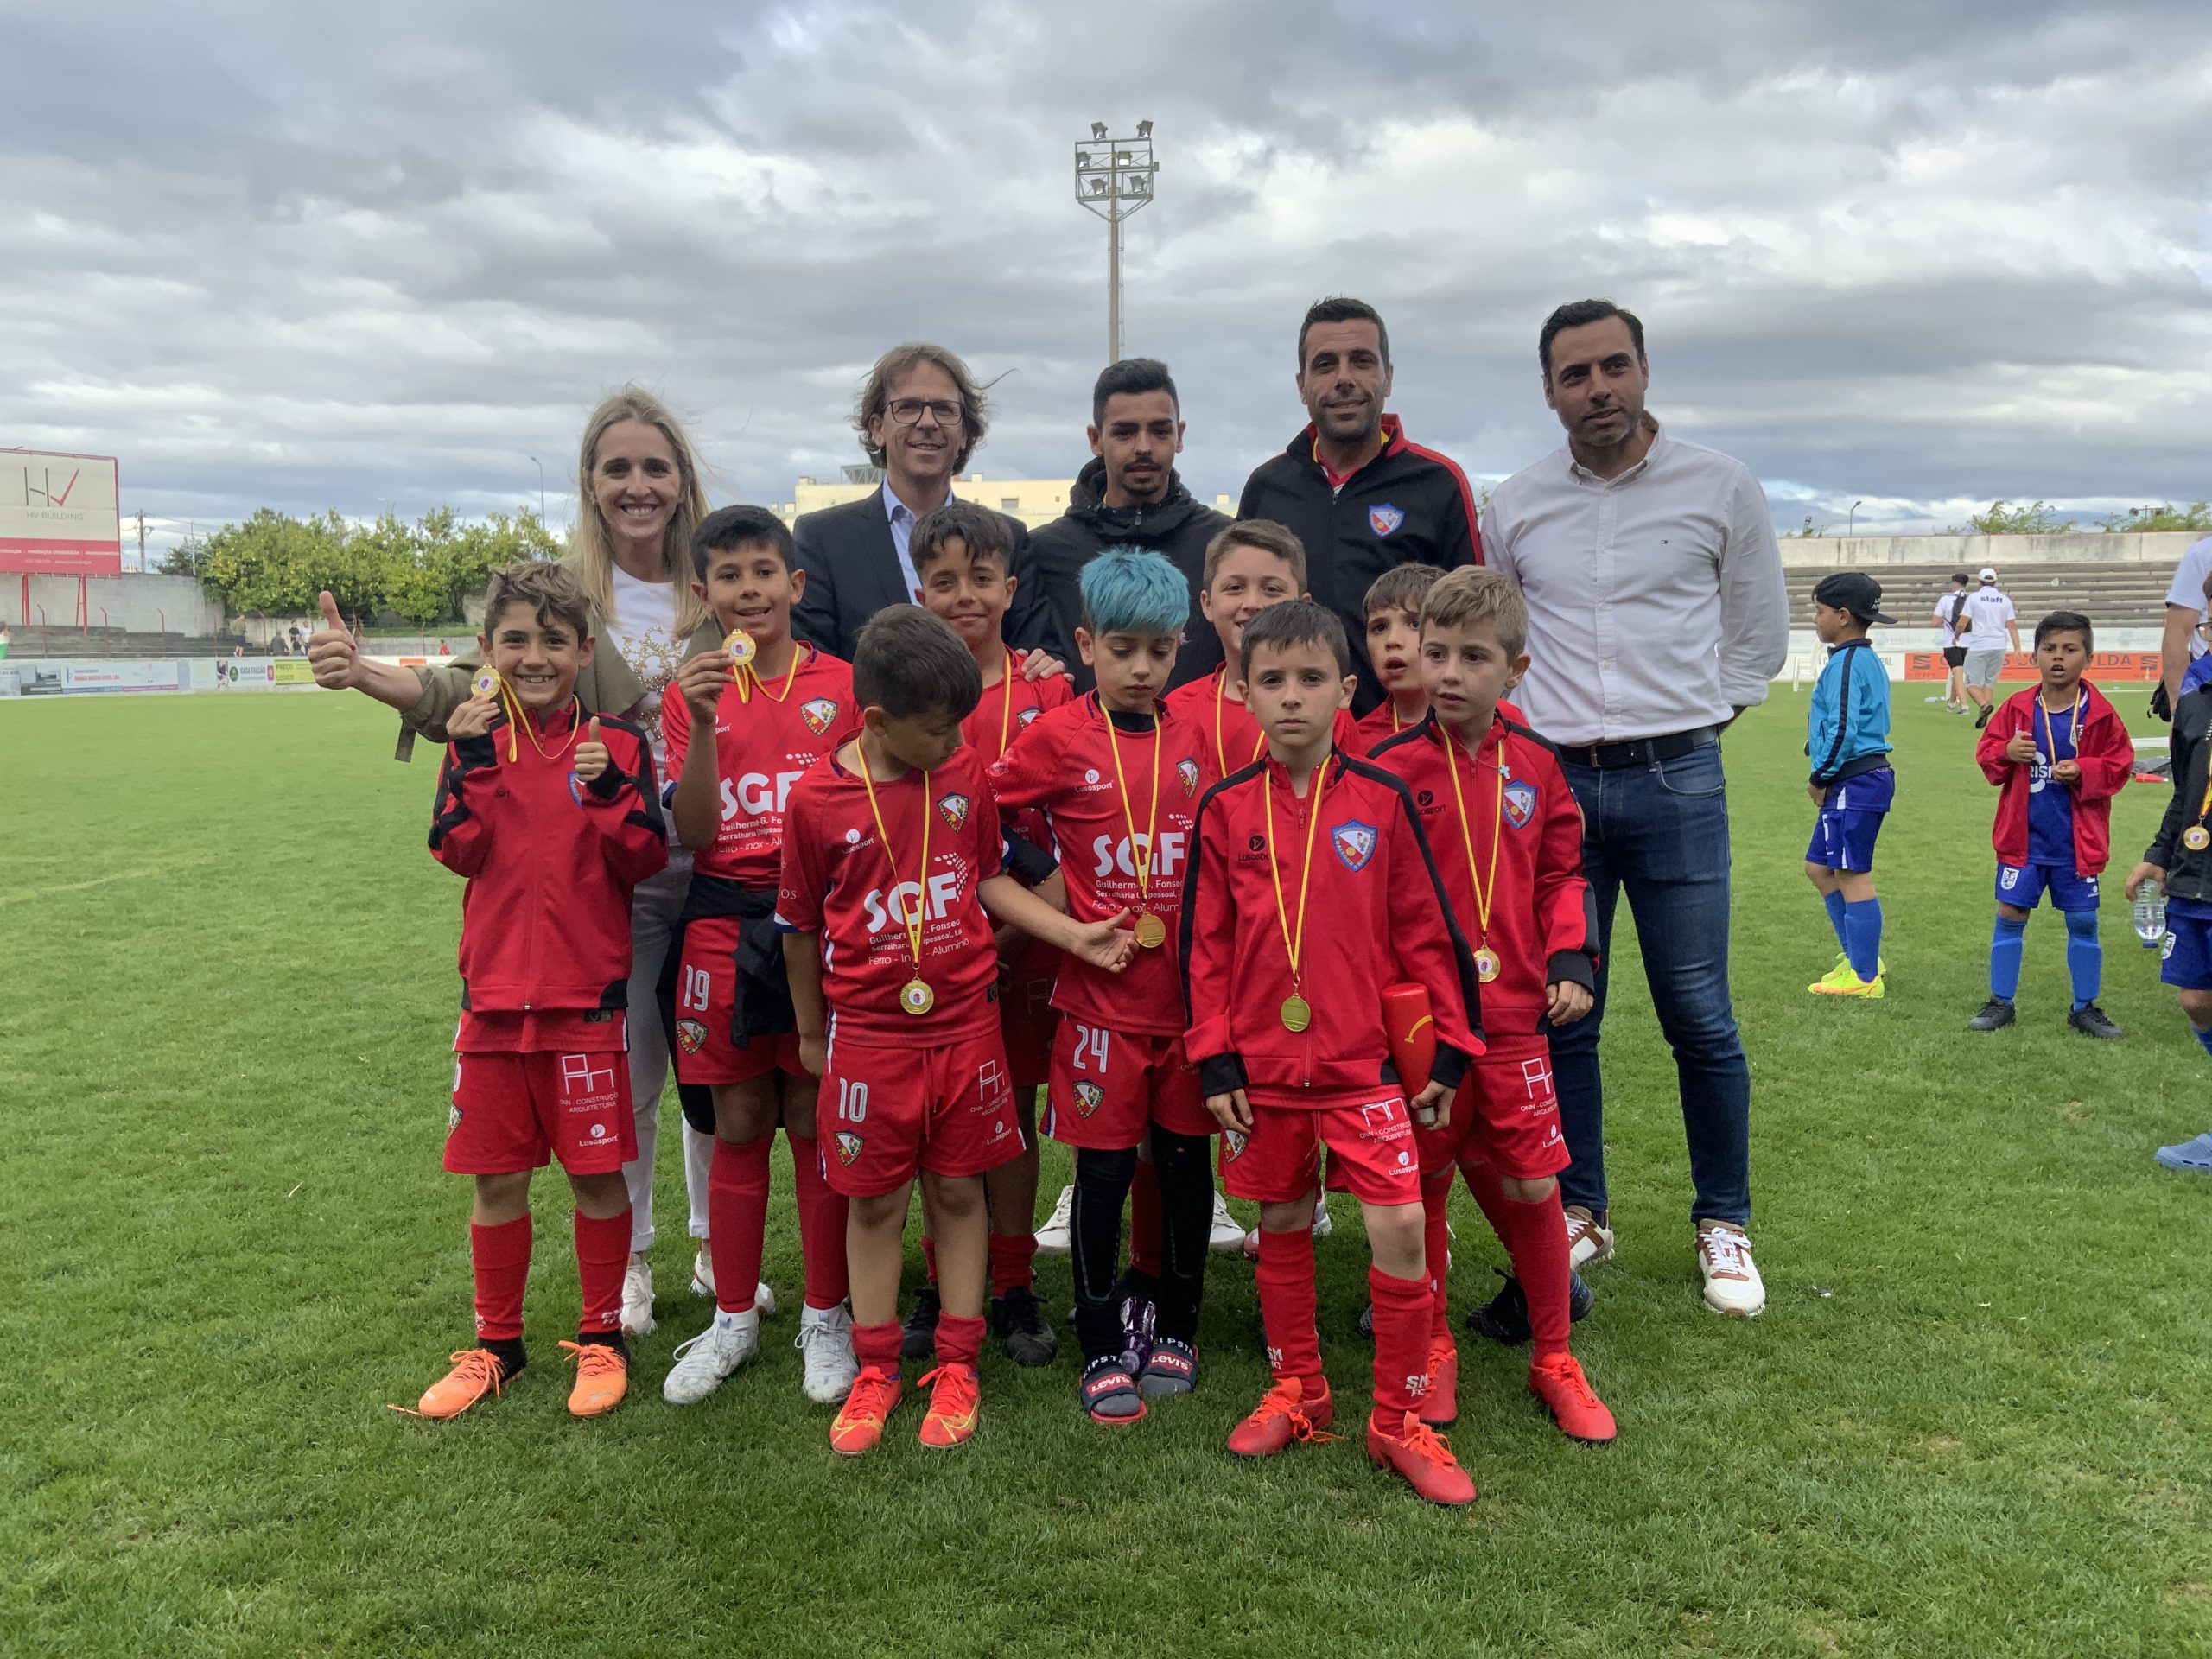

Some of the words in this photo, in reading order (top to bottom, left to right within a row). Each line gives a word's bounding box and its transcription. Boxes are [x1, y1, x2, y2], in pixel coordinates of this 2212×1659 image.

[26, 511, 40, 519] HV
[2097, 654, 2132, 666] LDA
[721, 819, 759, 832] Guilherme
[745, 842, 764, 851] Inox
[1093, 832, 1185, 878] SGF
[1096, 880, 1139, 889] Guilherm
[864, 872, 957, 933] SGF
[683, 964, 710, 1012] 19
[1073, 1024, 1109, 1073] 24
[569, 1100, 617, 1113] ARQUITETURA
[839, 1077, 868, 1123] 10
[579, 1135, 618, 1147] Lusosport
[1405, 1373, 1429, 1389] SM
